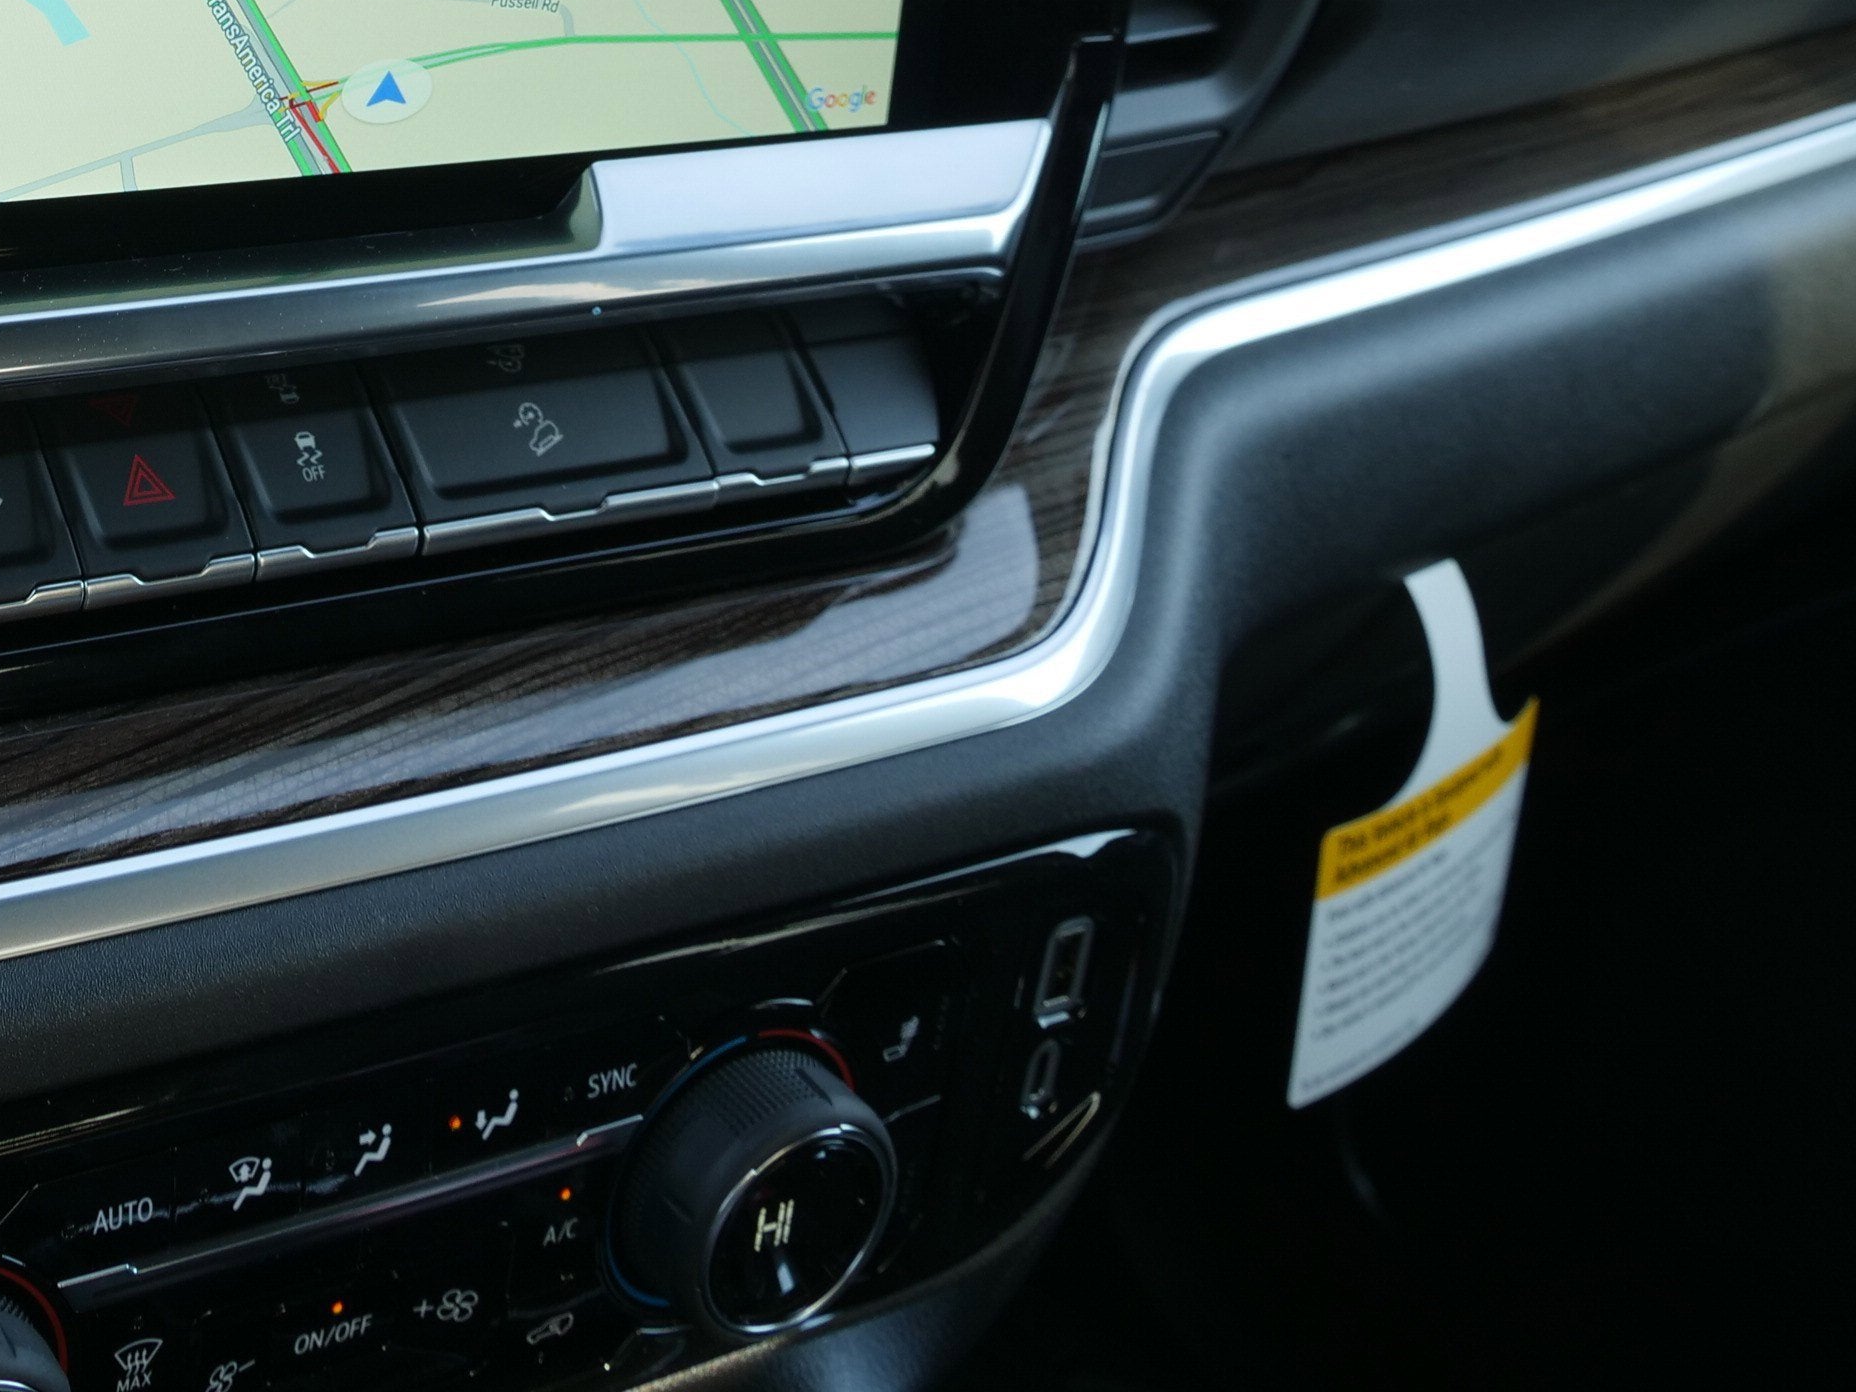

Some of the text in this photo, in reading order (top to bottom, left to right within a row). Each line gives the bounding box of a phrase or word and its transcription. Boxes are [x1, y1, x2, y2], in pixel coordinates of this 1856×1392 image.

[807, 84, 876, 113] Google
[275, 110, 301, 143] Trl
[302, 464, 326, 483] OFF
[586, 1062, 638, 1099] SYNC
[93, 1196, 154, 1235] AUTO
[542, 1216, 579, 1247] A/C
[754, 1198, 795, 1253] HI
[294, 1313, 374, 1356] ON/OFF
[116, 1369, 153, 1392] MAX
